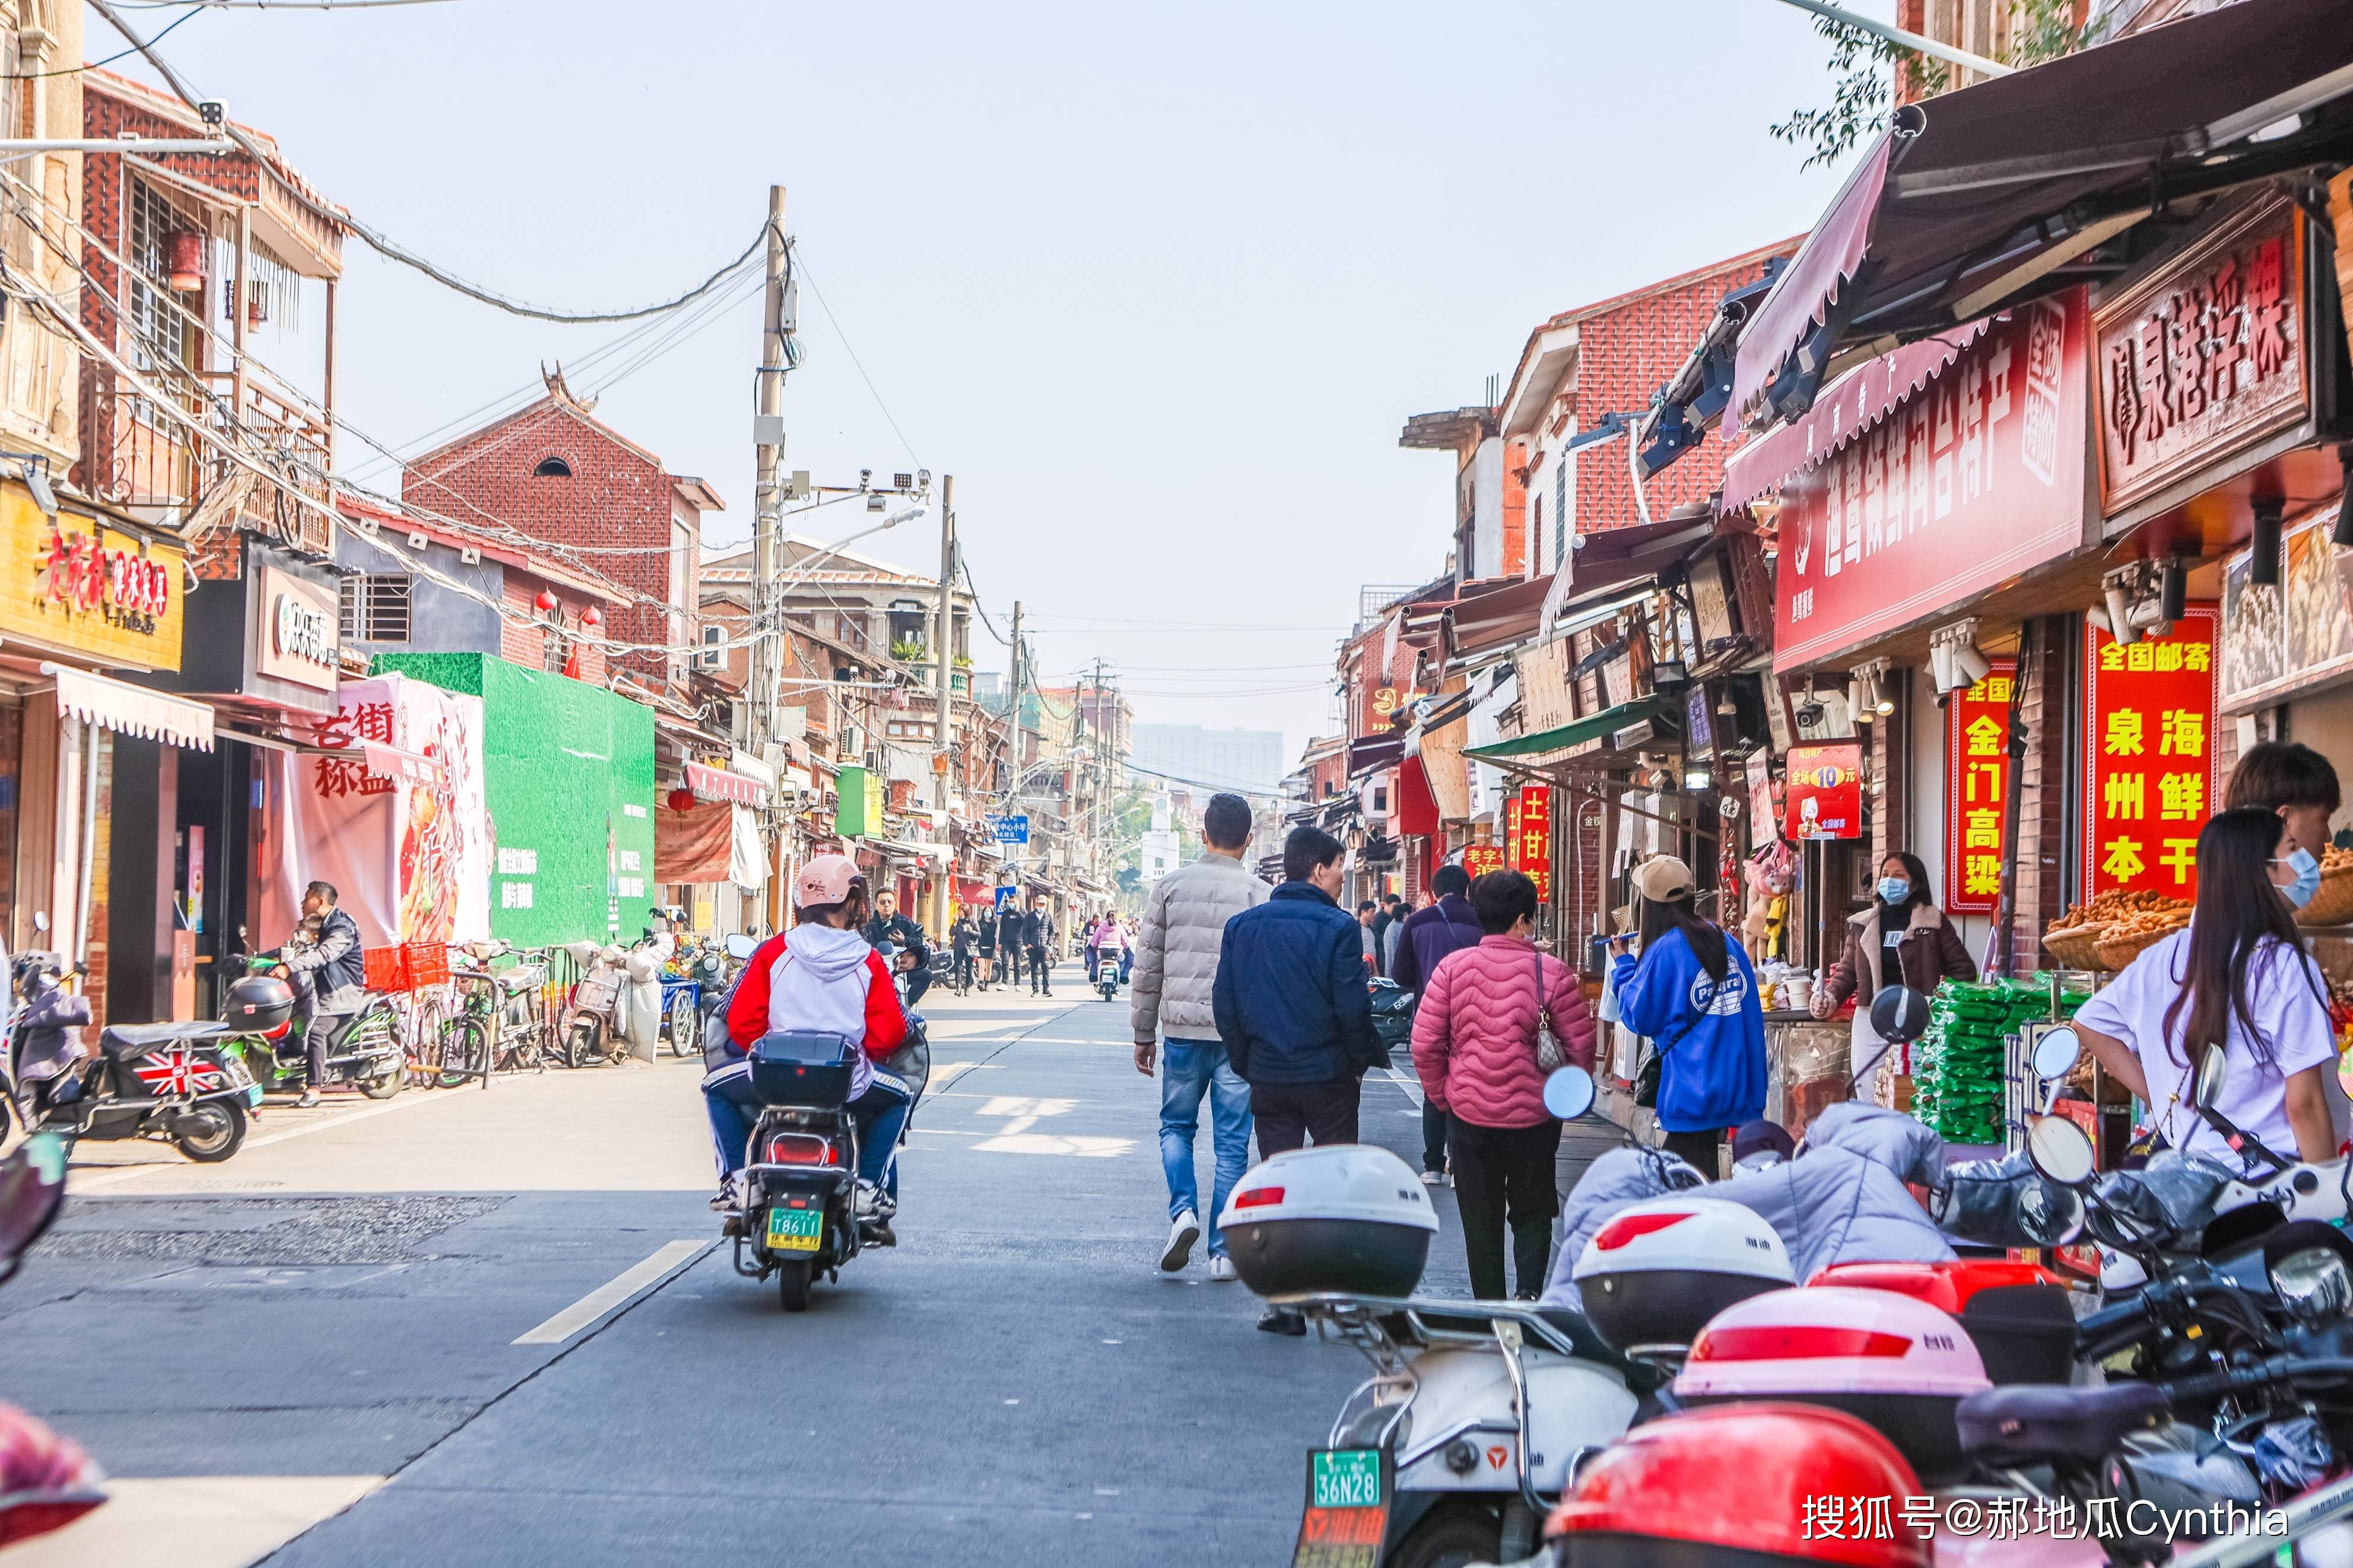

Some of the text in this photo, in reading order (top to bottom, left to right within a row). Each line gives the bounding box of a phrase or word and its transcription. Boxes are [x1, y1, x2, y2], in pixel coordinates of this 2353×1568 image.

[2099, 641, 2212, 672] 全国邮寄
[310, 701, 395, 749] 老街
[1965, 714, 2003, 895] 金门高粱
[1821, 818, 1846, 829] 全国邮寄
[774, 1217, 815, 1235] T8611
[1318, 1472, 1375, 1505] 36N28
